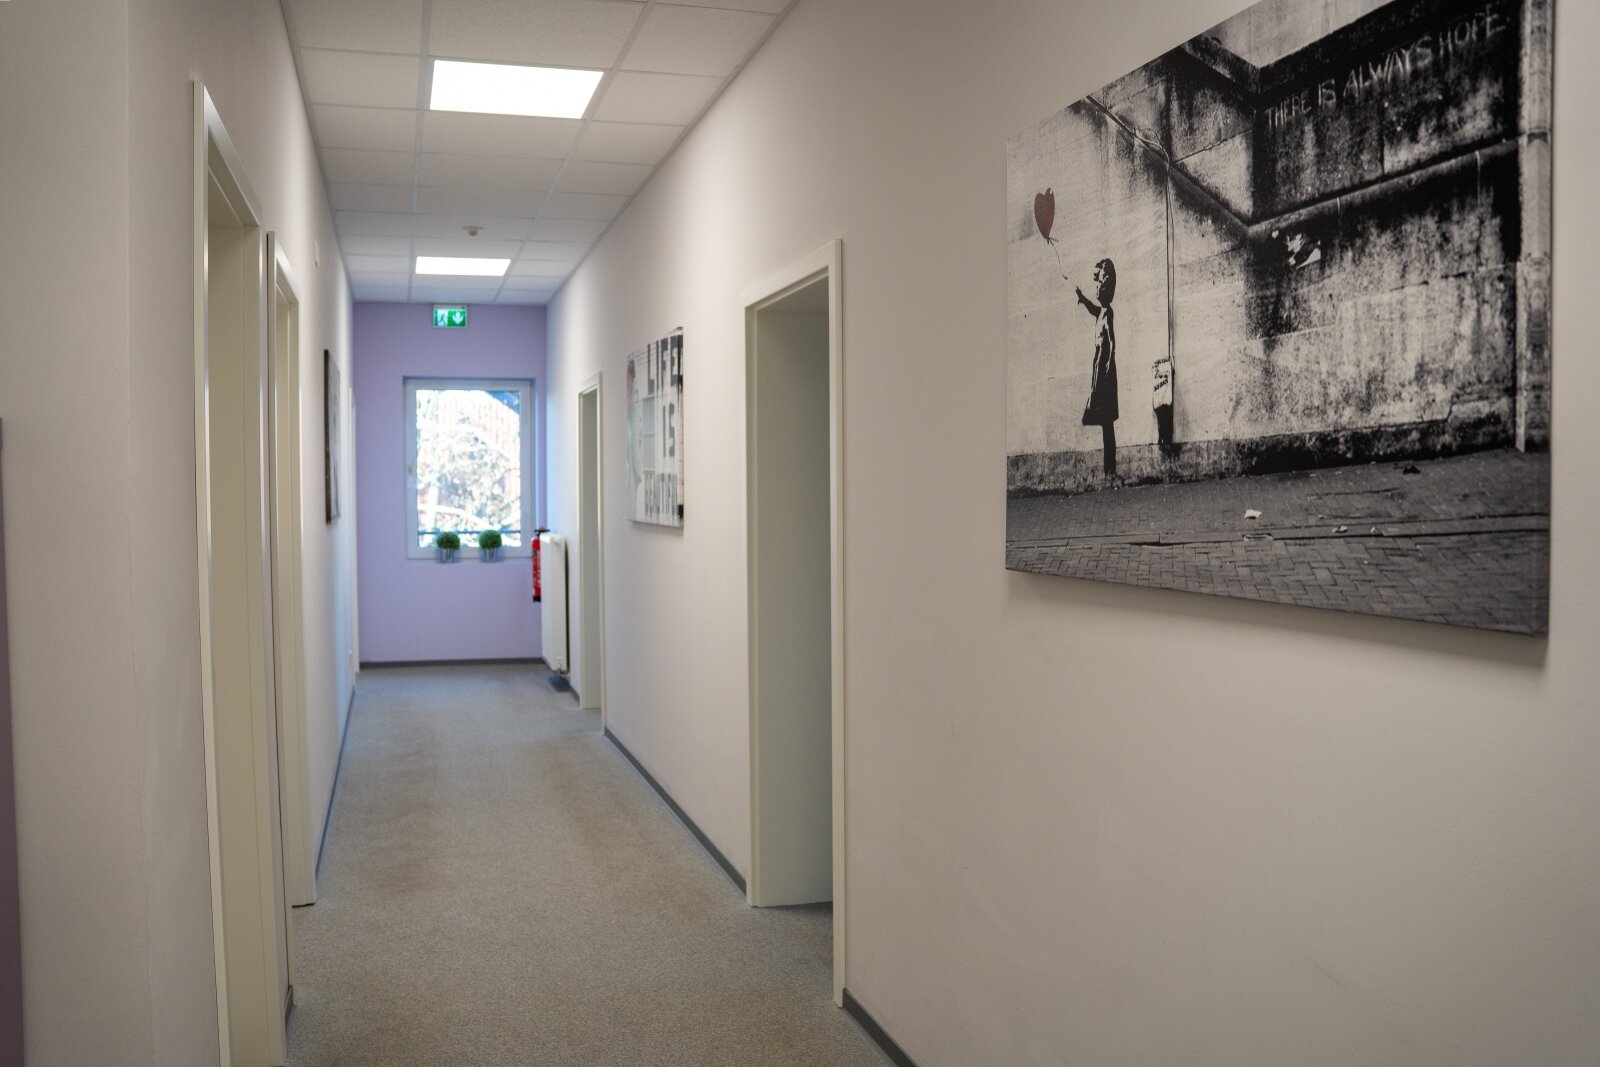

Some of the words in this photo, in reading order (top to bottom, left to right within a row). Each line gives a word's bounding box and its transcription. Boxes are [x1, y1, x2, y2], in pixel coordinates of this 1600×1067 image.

[1263, 89, 1312, 129] THERE
[1318, 79, 1337, 108] IS
[1342, 35, 1433, 98] ALWAYS
[1439, 4, 1506, 58] HOPE
[647, 335, 682, 394] LIFE
[662, 402, 676, 458] IS
